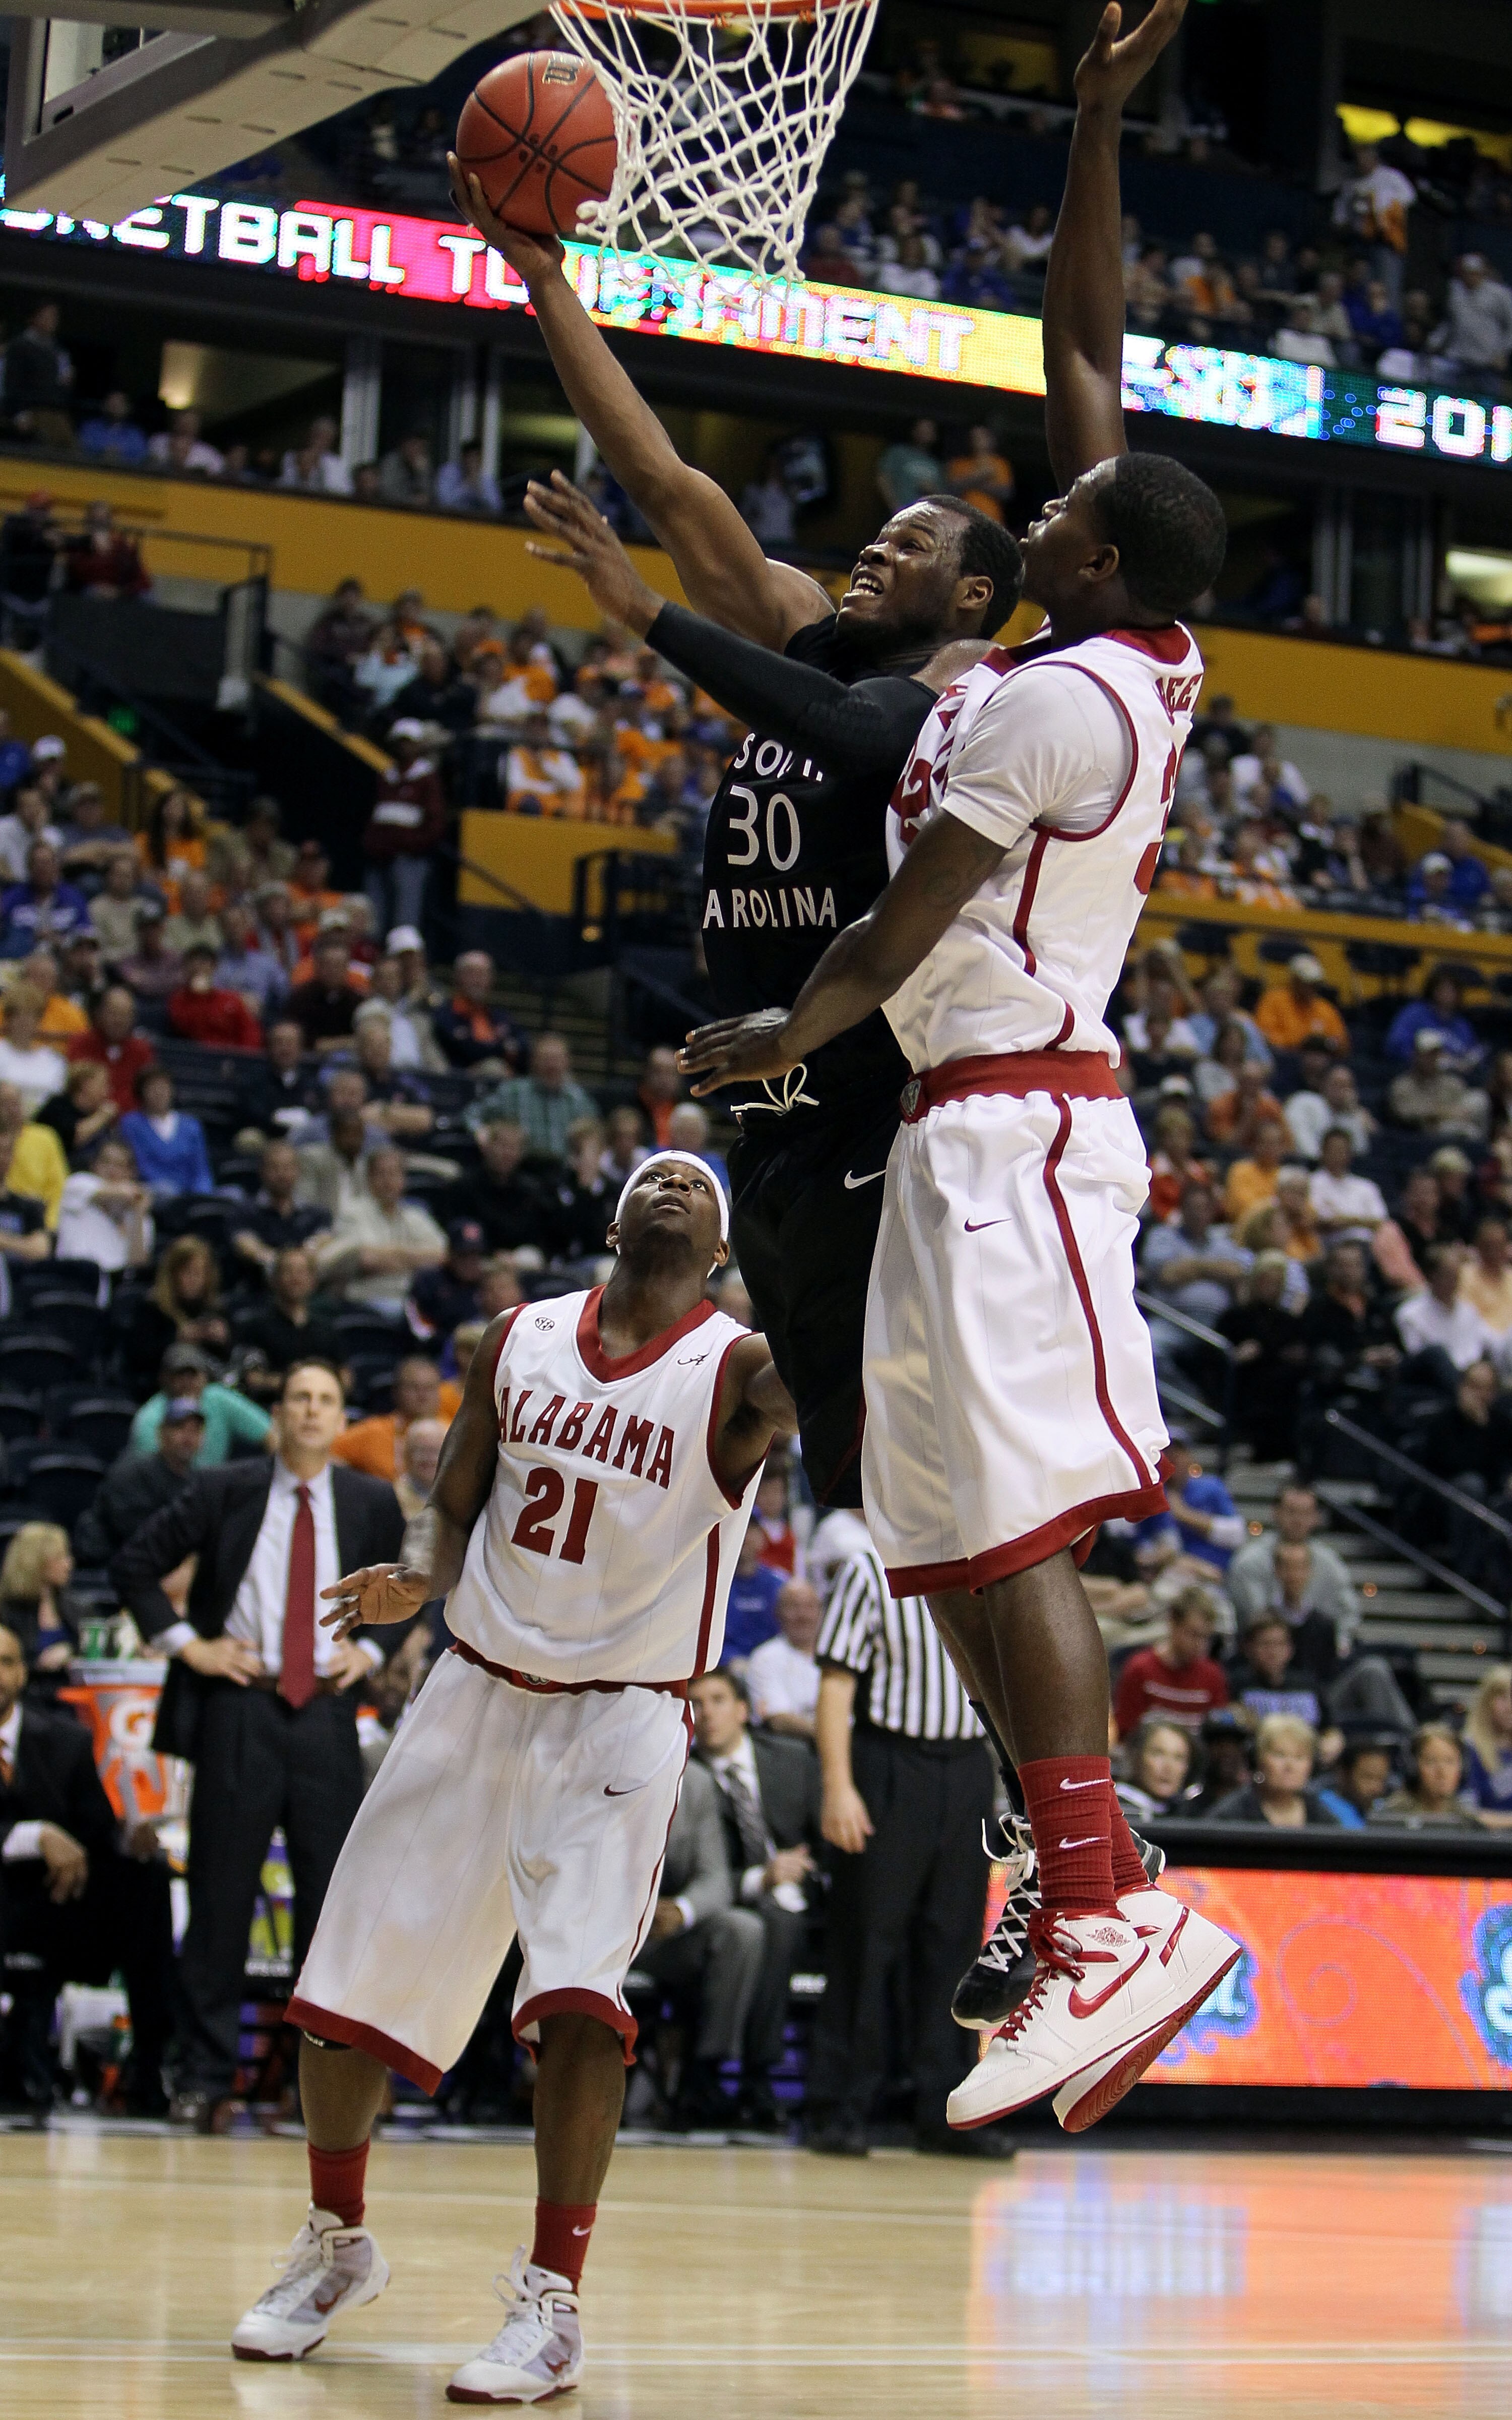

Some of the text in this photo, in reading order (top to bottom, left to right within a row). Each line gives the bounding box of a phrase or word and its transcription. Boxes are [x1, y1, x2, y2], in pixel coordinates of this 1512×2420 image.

[727, 784, 800, 872] 30
[535, 1317, 555, 1331] SEC
[498, 1387, 675, 1490] ALABAMA
[511, 1466, 599, 1565] 21
[109, 1701, 156, 1747] G
